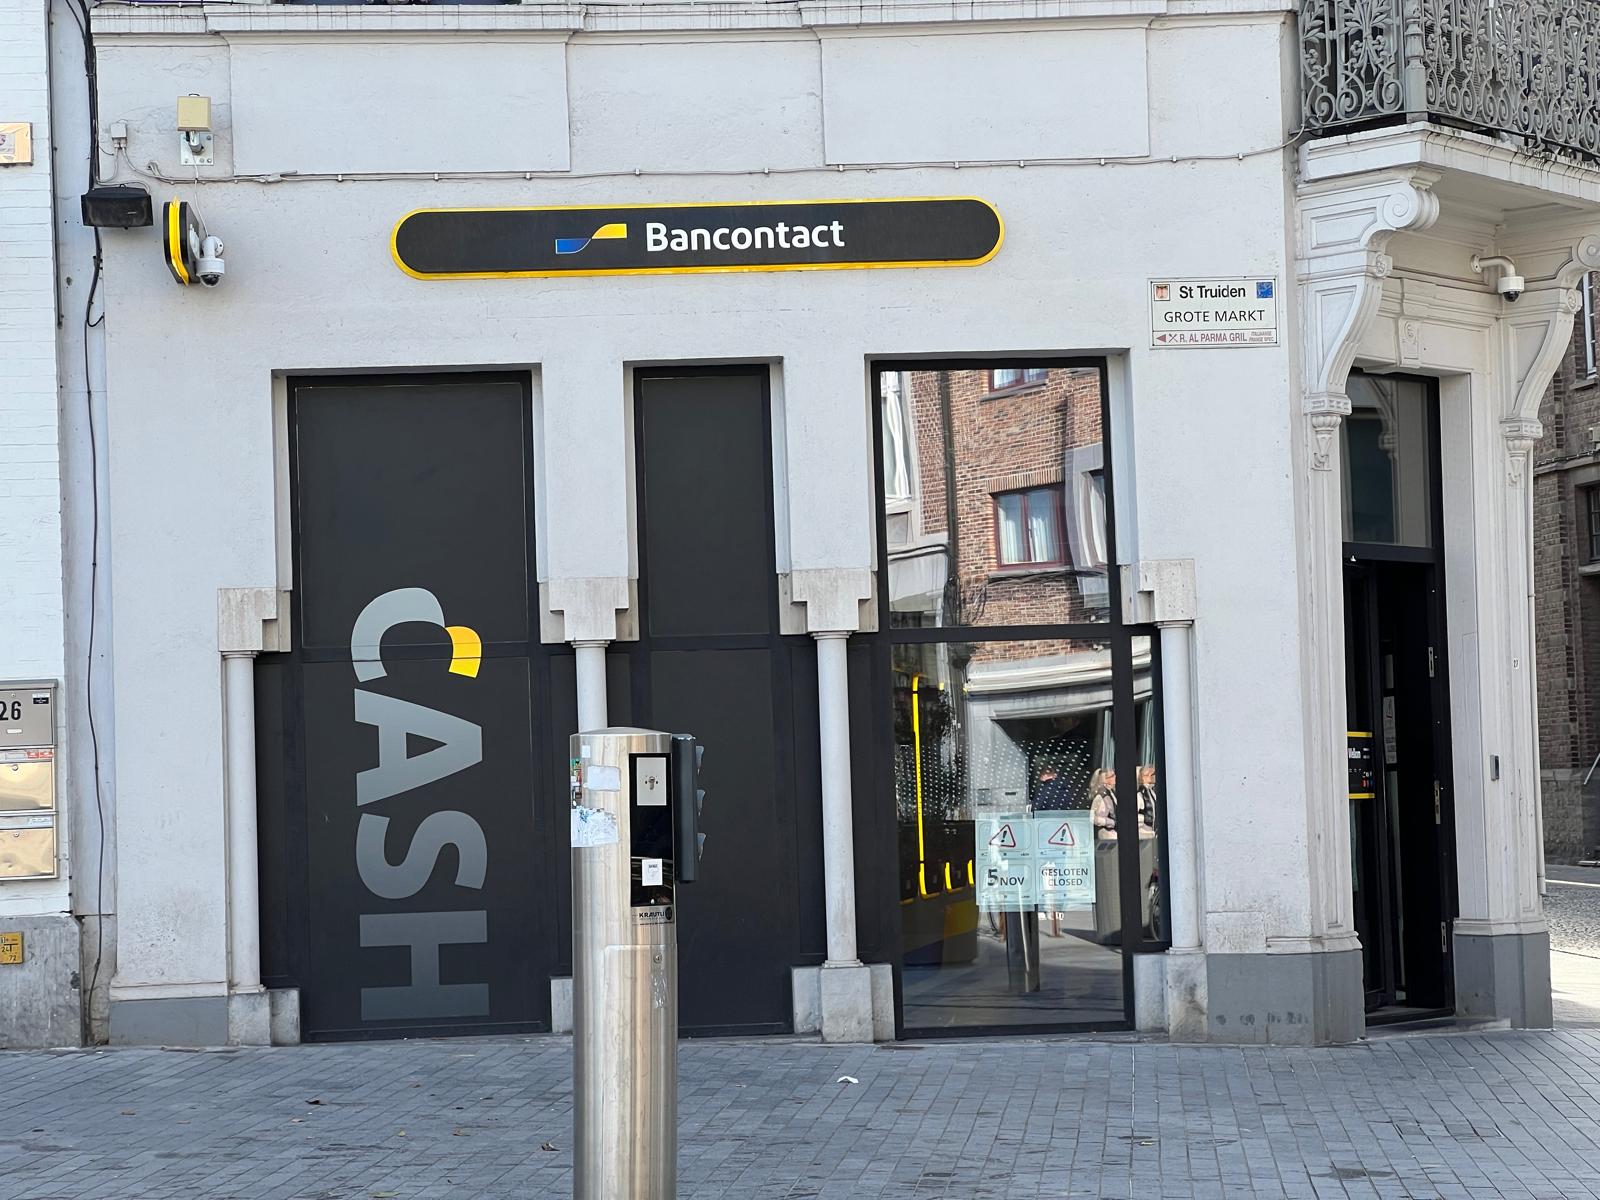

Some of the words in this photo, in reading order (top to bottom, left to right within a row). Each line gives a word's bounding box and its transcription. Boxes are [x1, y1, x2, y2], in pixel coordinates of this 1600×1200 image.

[646, 220, 845, 252] Bancontact
[1179, 285, 1194, 299] St
[1197, 285, 1246, 298] Truiden
[1164, 311, 1210, 322] GROTE
[1215, 309, 1265, 321] MARKT
[1180, 333, 1187, 342] R.
[1189, 333, 1199, 342] AL
[1201, 333, 1228, 342] PARMA
[1229, 332, 1247, 341] GRIL
[0, 701, 22, 720] 26
[350, 587, 490, 1020] CASH
[987, 868, 998, 886] 5
[1000, 876, 1025, 886] NOV
[1041, 868, 1089, 877] GESLOTEN
[1048, 878, 1083, 886] CLOSED
